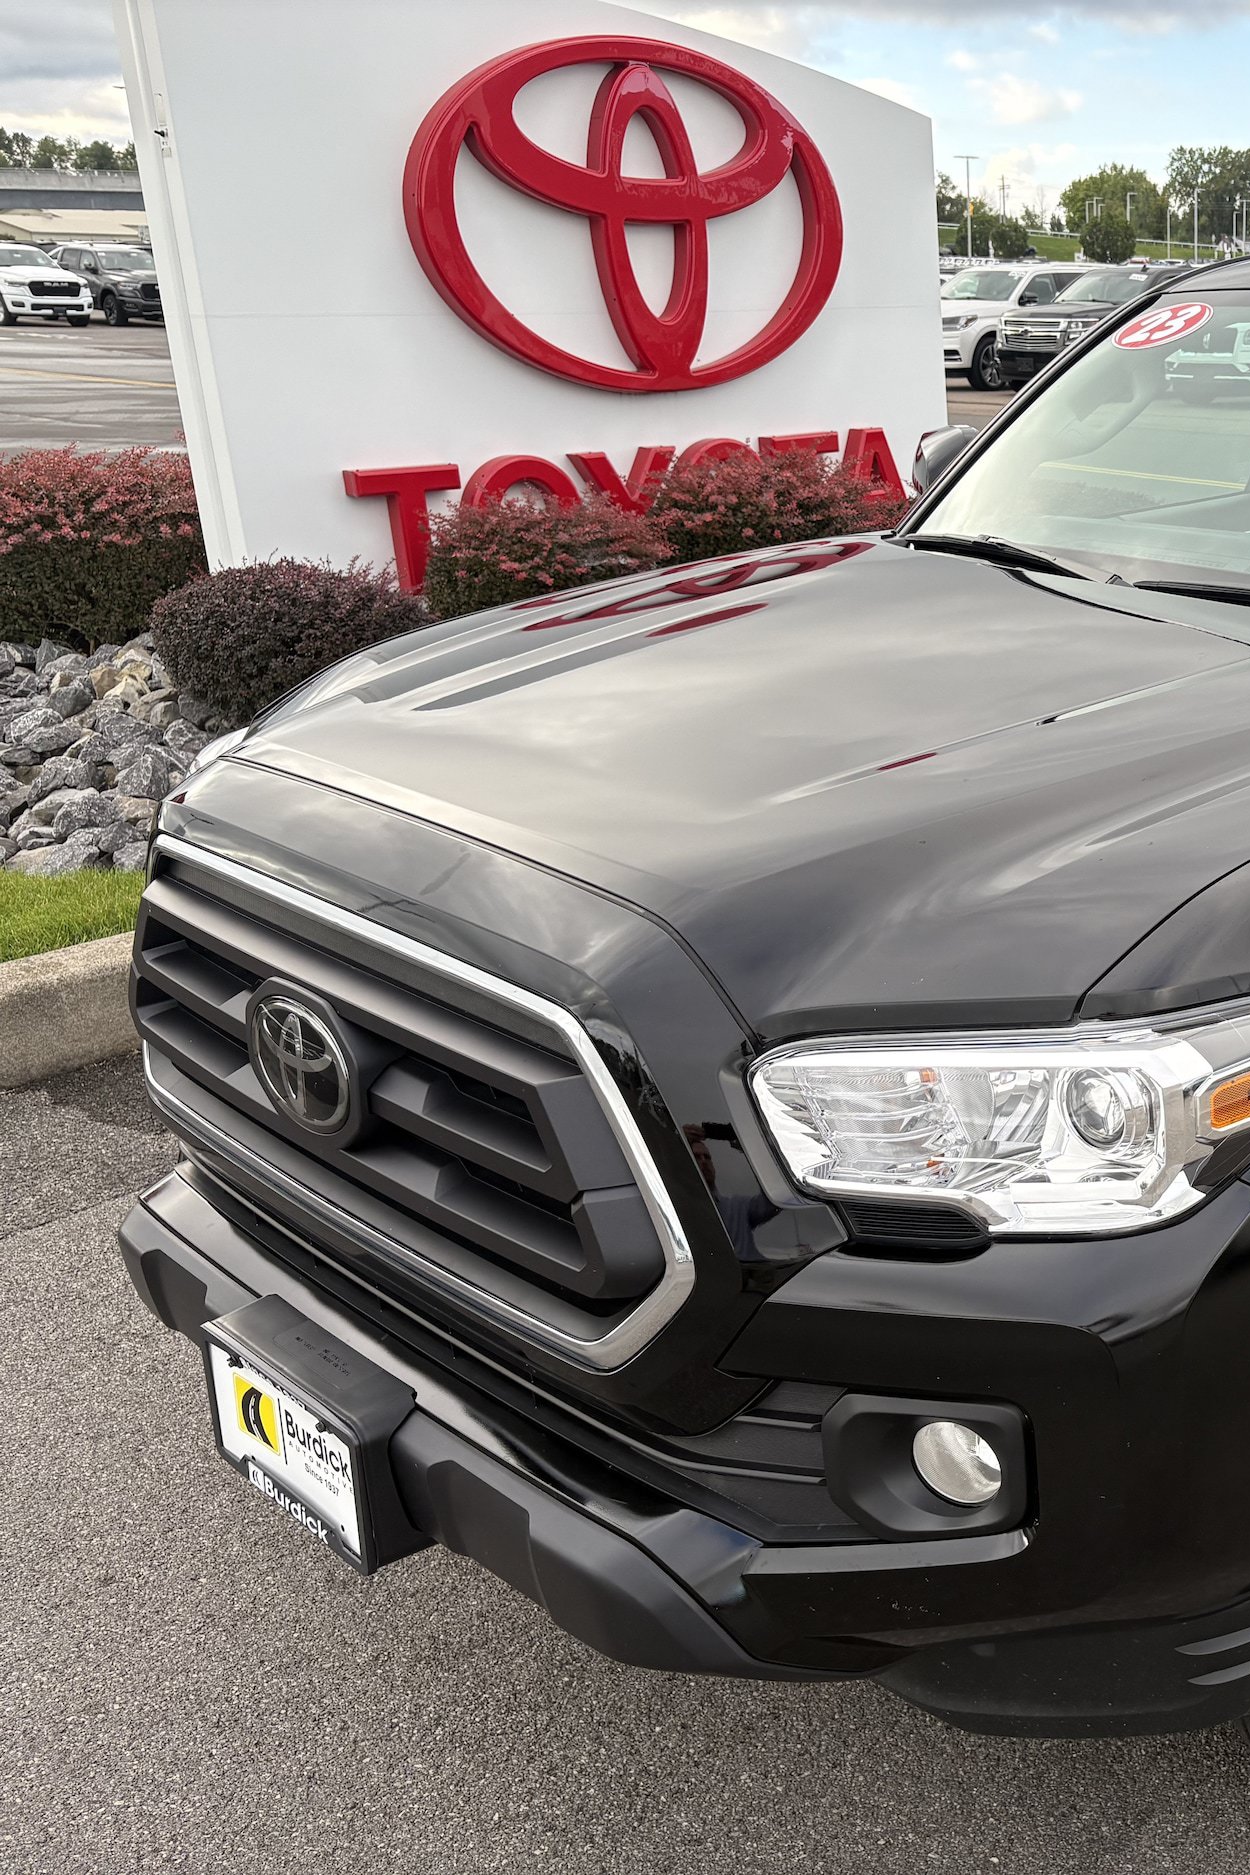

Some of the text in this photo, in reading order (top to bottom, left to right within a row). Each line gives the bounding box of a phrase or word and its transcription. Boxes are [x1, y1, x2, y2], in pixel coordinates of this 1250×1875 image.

[1119, 304, 1203, 346] 23
[342, 427, 911, 597] TOYA
[283, 1409, 353, 1483] Burdick
[288, 1440, 355, 1494] AUTOMOTIVE
[264, 1475, 329, 1545] Burdick
[304, 1462, 340, 1497] Since 1937
